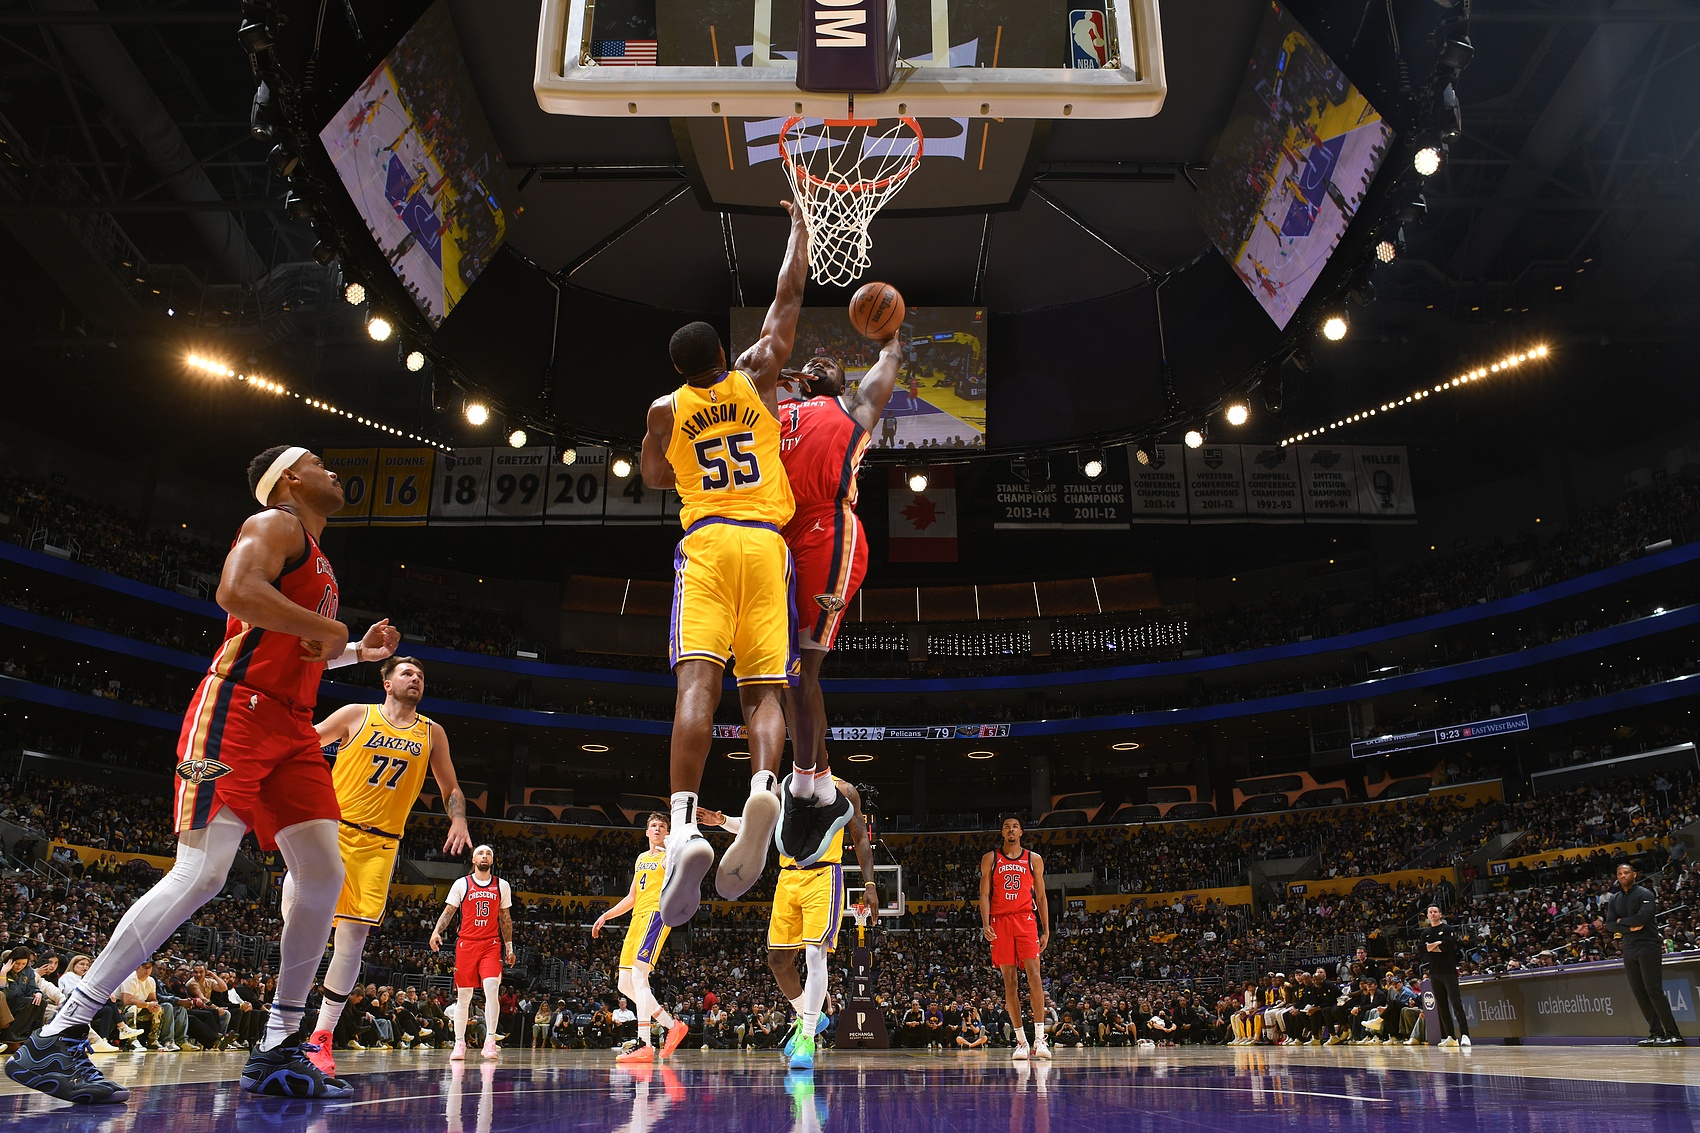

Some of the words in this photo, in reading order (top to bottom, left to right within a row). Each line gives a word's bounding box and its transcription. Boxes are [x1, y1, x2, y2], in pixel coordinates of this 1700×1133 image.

[815, 0, 866, 47] M
[1077, 59, 1095, 69] NBA
[872, 290, 894, 322] Wilson
[681, 403, 737, 440] JEMISON
[742, 407, 760, 428] III
[788, 408, 800, 433] 1
[780, 434, 802, 451] ITY
[330, 457, 369, 466] VACHON
[386, 456, 426, 466] DIONNE
[497, 455, 543, 465] GRETZKY
[694, 432, 762, 491] 55
[1362, 455, 1401, 465] MILLER
[1139, 472, 1175, 480] WESTERN
[1196, 472, 1233, 480] WESTERN
[1313, 472, 1343, 480] SMYTHE
[344, 475, 366, 506] 0
[384, 475, 418, 506] 16
[443, 475, 476, 505] 18
[496, 473, 540, 504] 99
[554, 473, 599, 504] 20
[623, 474, 644, 504] 4
[996, 484, 1031, 493] STANLE
[1063, 484, 1104, 493] STANLEY
[1105, 484, 1123, 493] CUP
[1134, 481, 1181, 489] CONFERENCE
[1191, 481, 1240, 489] CONFERENCE
[1248, 481, 1297, 489] CONFERENCE
[996, 493, 1057, 503] CHAMPIONS
[1063, 494, 1125, 504] CHAMPIONS
[1137, 490, 1180, 498] CHAMPIONS
[1194, 490, 1239, 498] CHAMPIONS
[1143, 500, 1175, 509] 2013-14
[1202, 500, 1234, 509] 2011-12
[1257, 500, 1292, 509] 1992-93
[1314, 500, 1348, 509] 1990-91
[1005, 506, 1050, 519] 2013-14
[1073, 507, 1117, 519] 2011-12
[838, 728, 868, 739] 1:32
[890, 730, 922, 738] Pelicans
[934, 727, 949, 738] 79
[1440, 729, 1460, 741] 9:23
[362, 731, 422, 756] LAKERS
[368, 755, 408, 790] 77
[998, 864, 1027, 875] CRESCENT
[1493, 863, 1507, 873] 117
[639, 872, 647, 890] 4
[1003, 873, 1021, 890] 25
[468, 890, 497, 901] CRESCENT
[1292, 886, 1304, 894] 117
[1005, 892, 1019, 900] CITY
[476, 900, 490, 917] 15
[474, 919, 489, 927] CITY
[1537, 993, 1614, 1016] uclahealth.org
[1663, 989, 1689, 1011] LA
[1478, 999, 1517, 1021] Health
